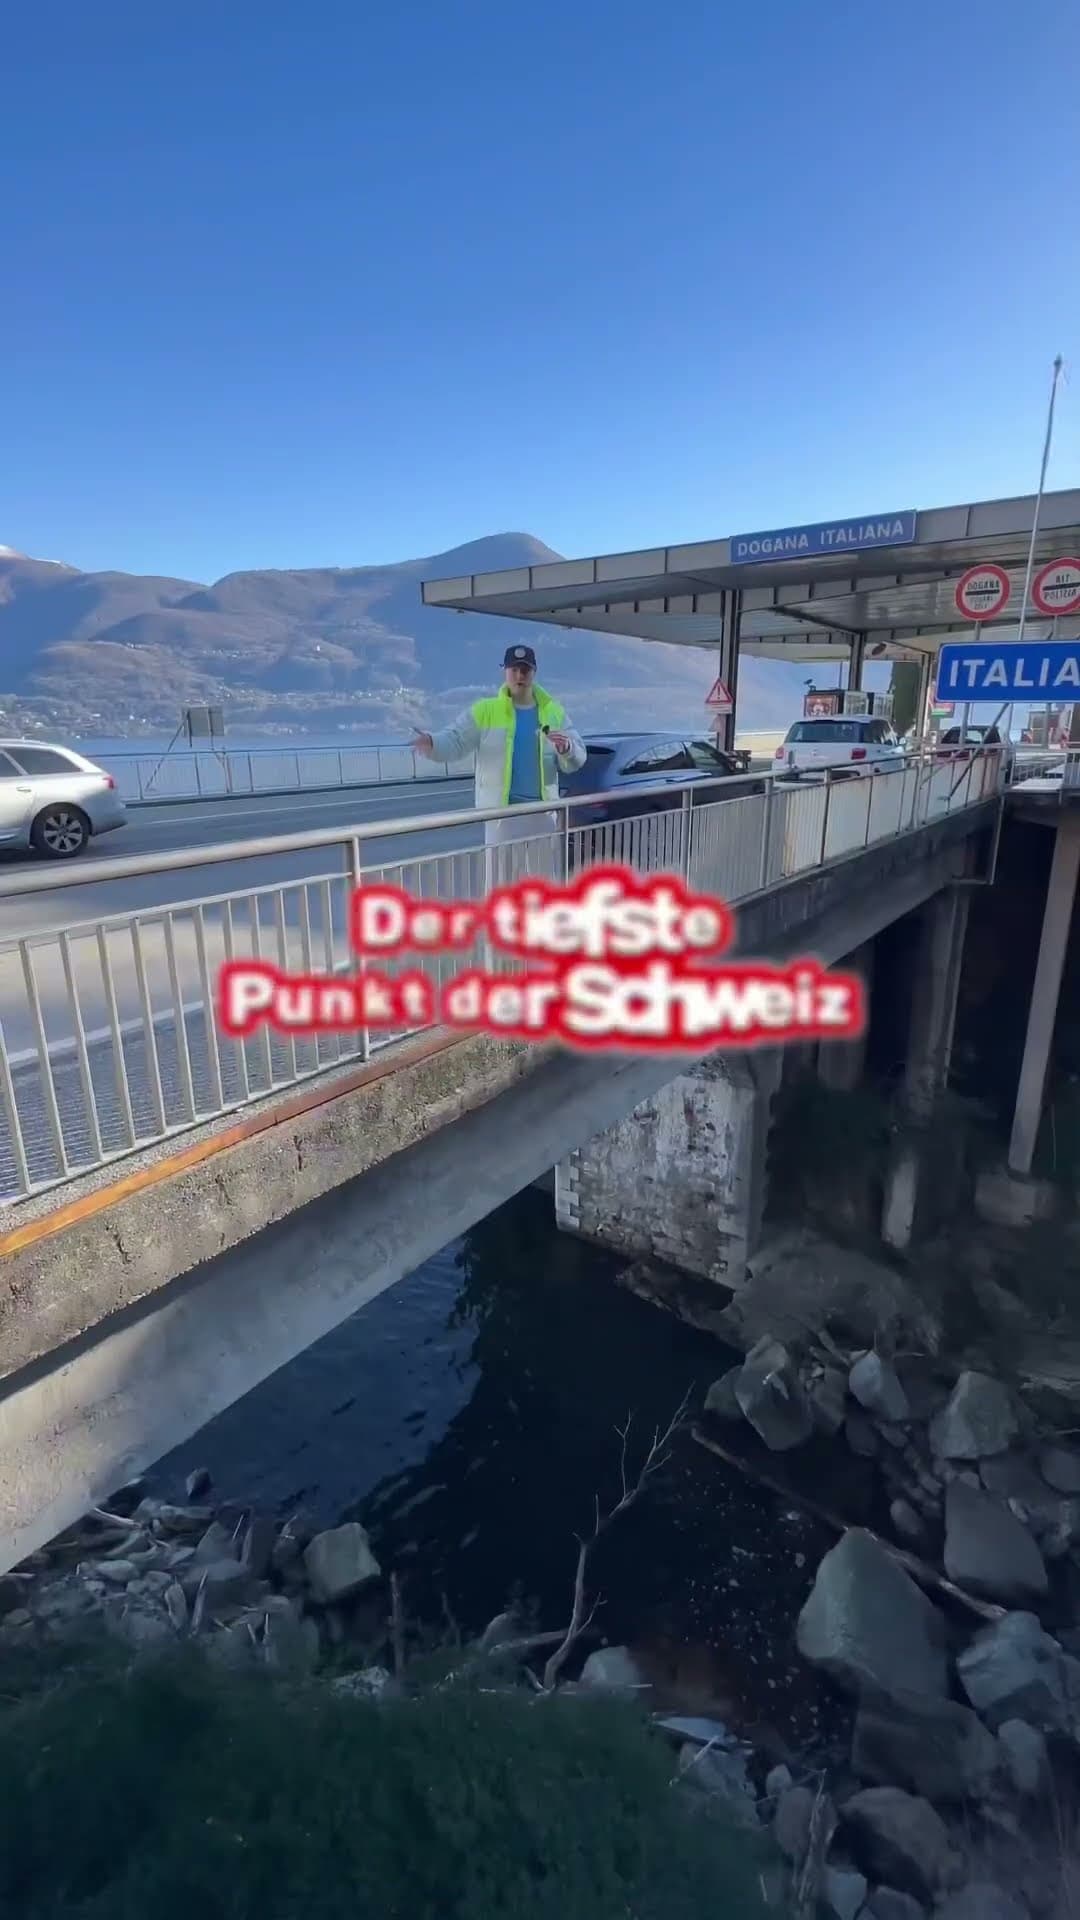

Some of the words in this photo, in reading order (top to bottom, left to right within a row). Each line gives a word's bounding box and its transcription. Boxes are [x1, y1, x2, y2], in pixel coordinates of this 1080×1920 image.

[738, 534, 808, 556] DOGANA
[820, 520, 904, 545] ITALIANA
[949, 657, 1080, 687] ITALIA
